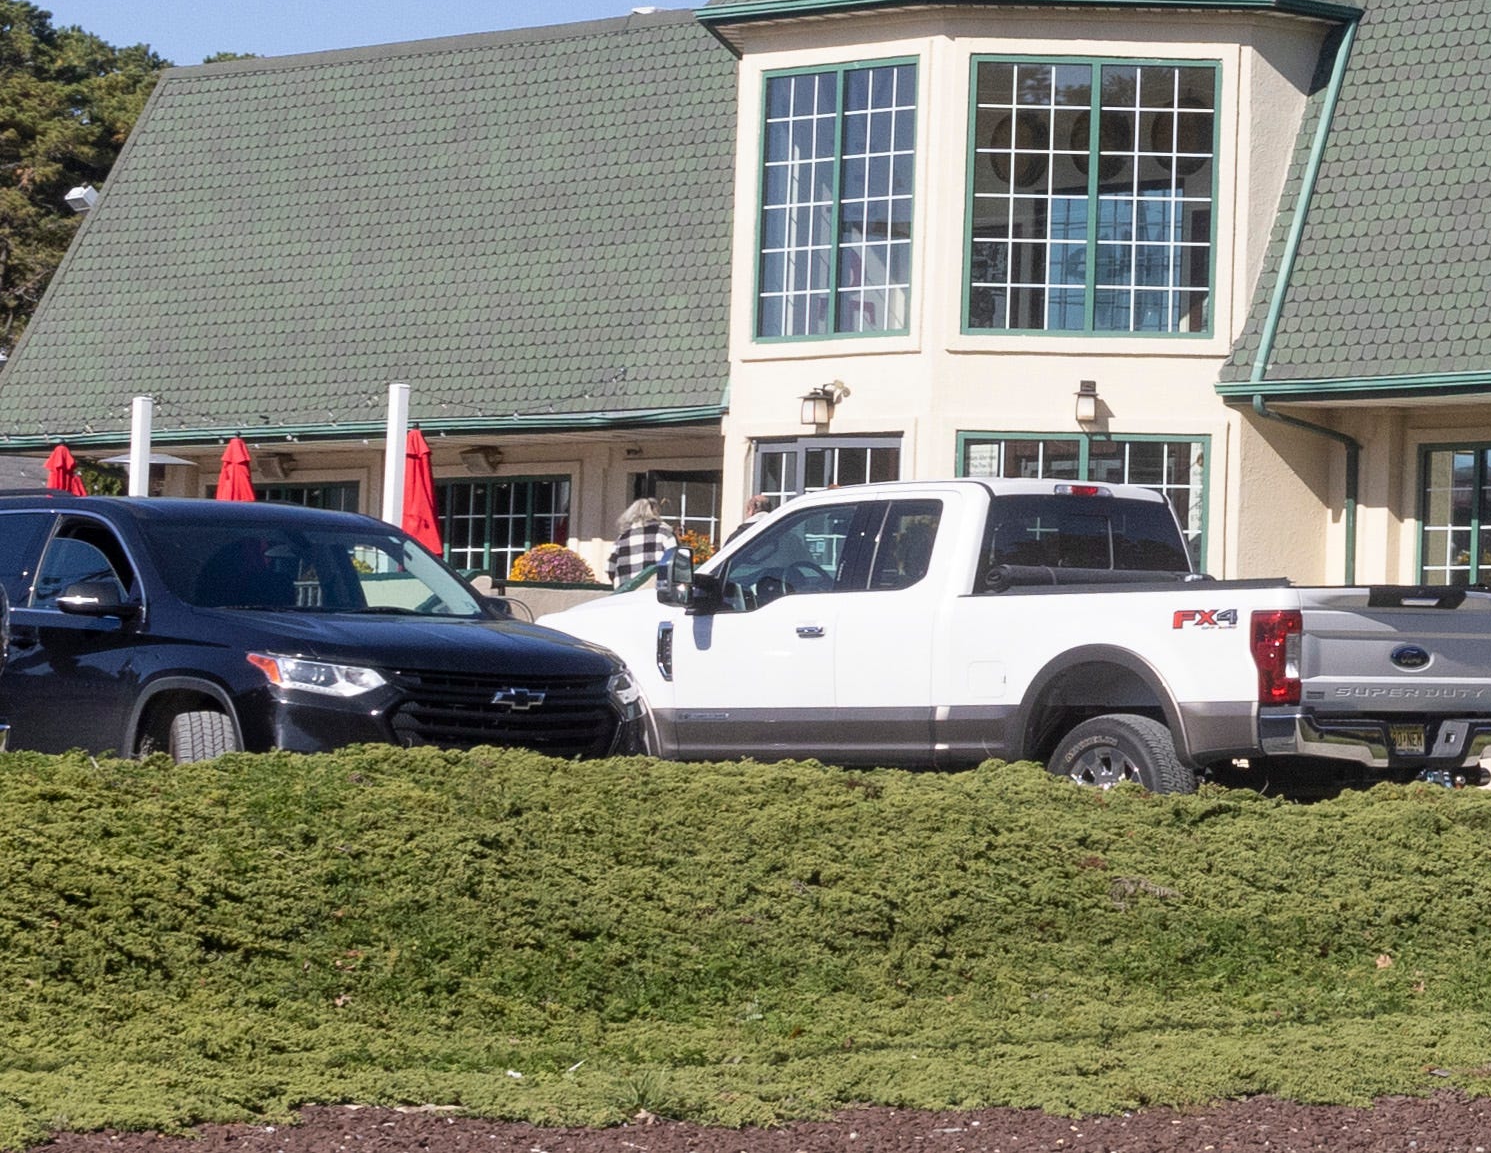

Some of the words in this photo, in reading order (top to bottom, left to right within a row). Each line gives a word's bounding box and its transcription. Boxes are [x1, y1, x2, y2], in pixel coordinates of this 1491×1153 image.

[1172, 608, 1238, 629] FX4
[1335, 687, 1420, 698] SUPER
[1424, 688, 1486, 698] DUTY
